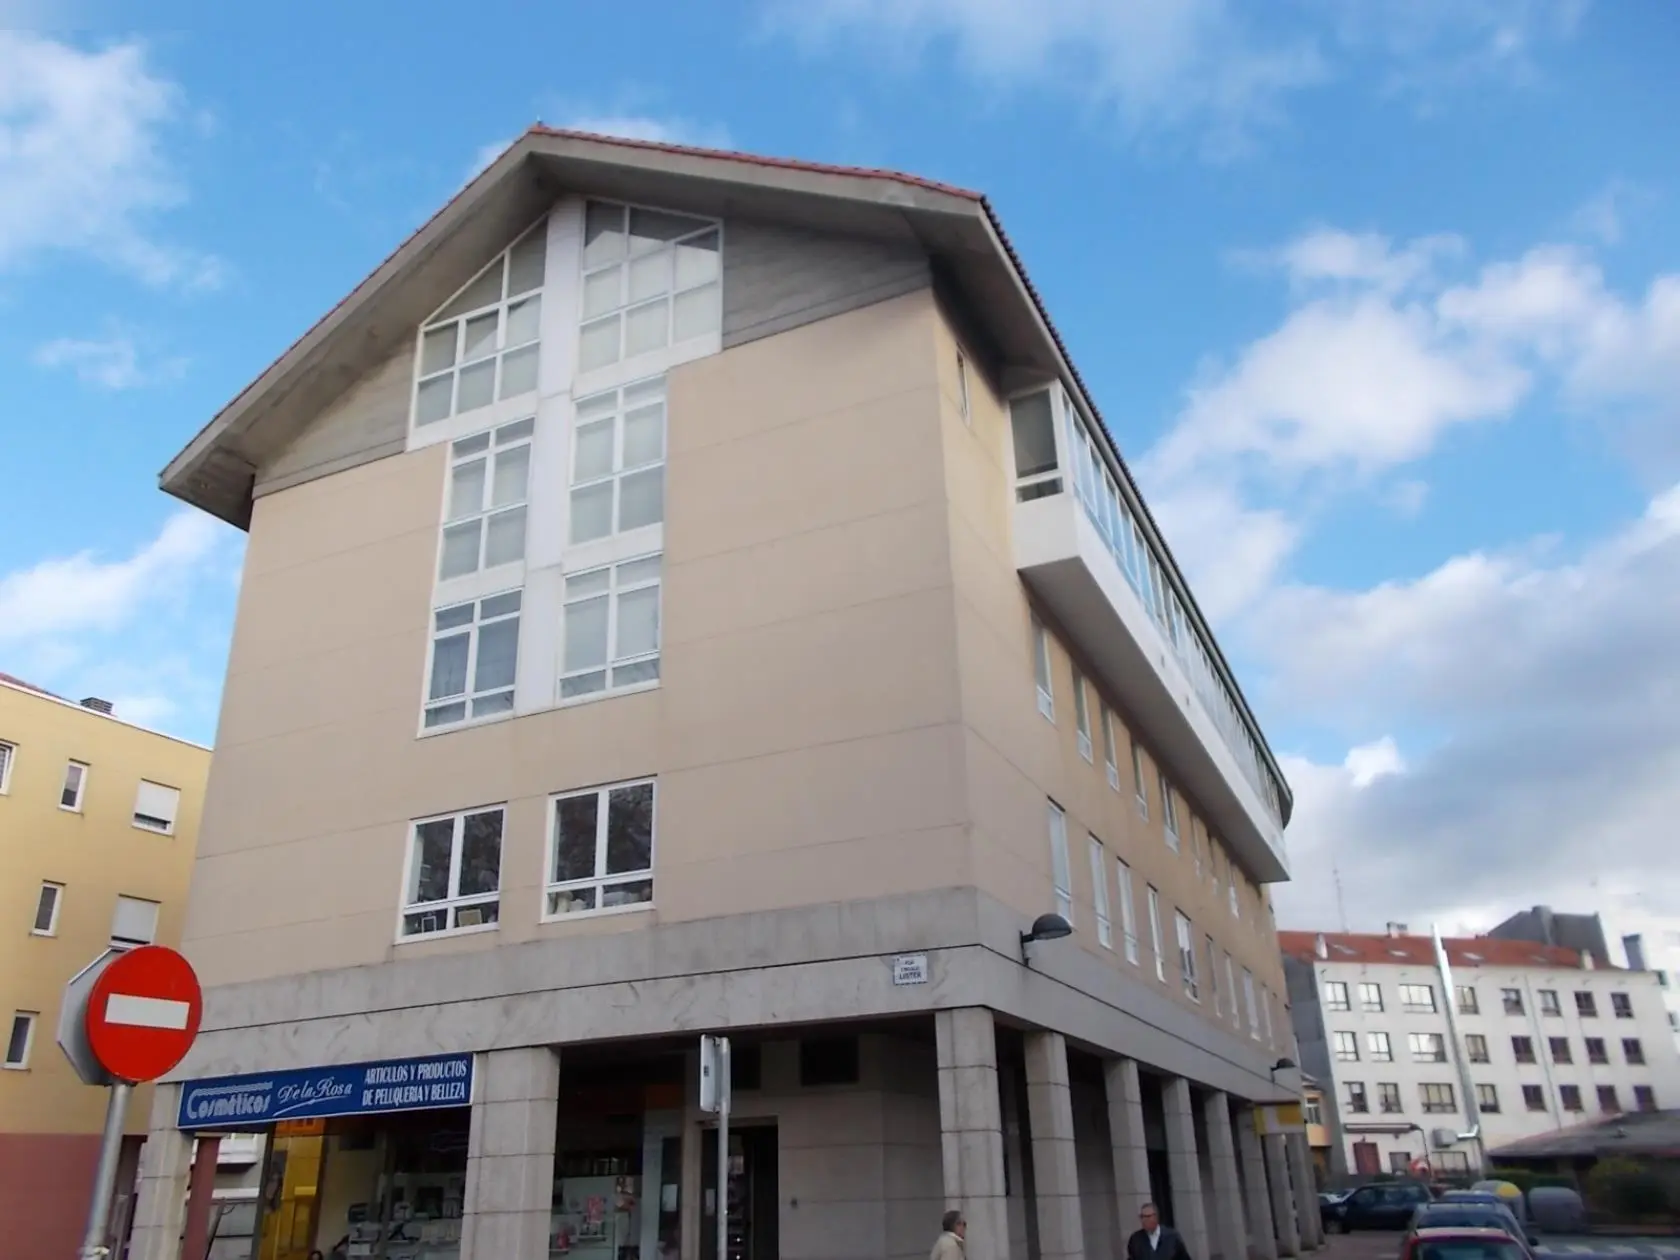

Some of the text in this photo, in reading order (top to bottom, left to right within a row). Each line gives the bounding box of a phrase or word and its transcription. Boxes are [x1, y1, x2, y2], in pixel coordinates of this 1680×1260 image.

[410, 1064, 416, 1081] Y
[417, 1060, 467, 1080] PRODUCTOS
[313, 1076, 353, 1098] Rosa
[362, 1089, 374, 1106] DE
[423, 1084, 431, 1102] Y
[431, 1082, 465, 1101] BELLEZA
